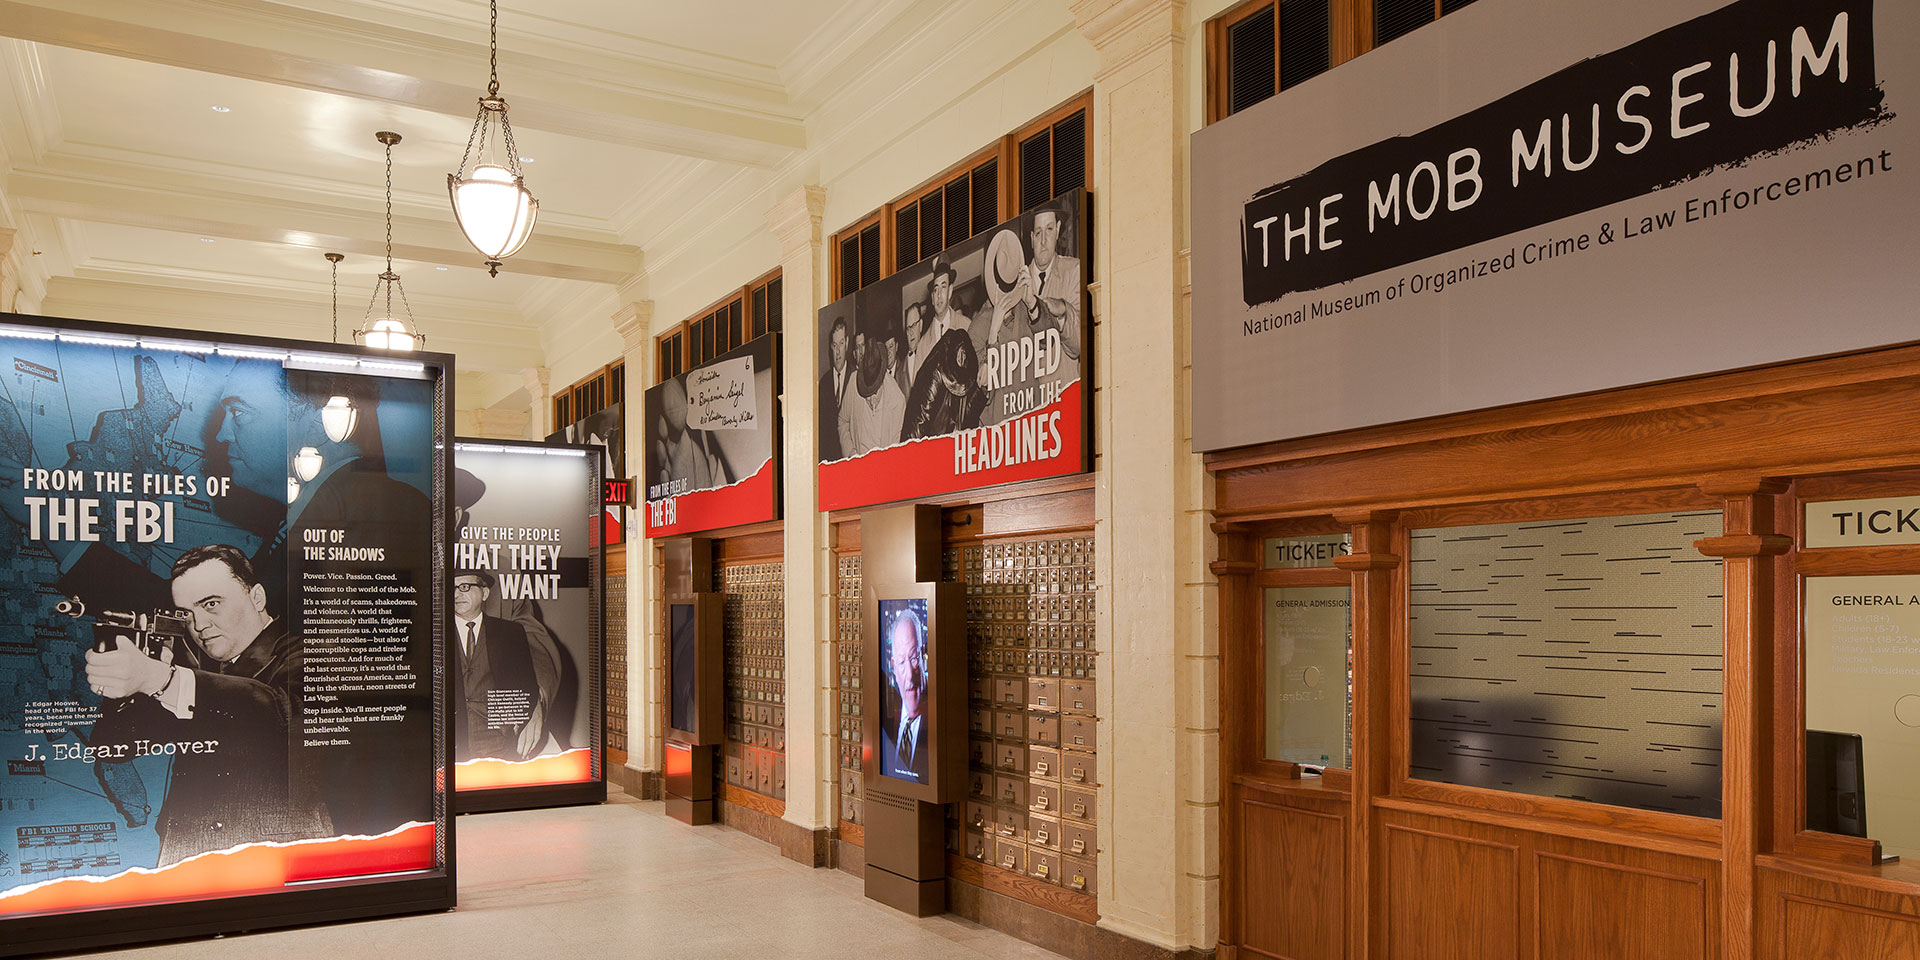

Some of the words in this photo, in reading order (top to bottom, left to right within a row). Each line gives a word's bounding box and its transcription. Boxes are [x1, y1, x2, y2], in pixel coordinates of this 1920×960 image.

[1252, 193, 1344, 268] THE
[1367, 147, 1484, 235] MOB
[1509, 10, 1849, 189] MUSEUM
[1242, 302, 1306, 338] National
[1310, 287, 1380, 319] Museum
[1385, 278, 1406, 301] of
[1410, 248, 1516, 297] Organized
[1522, 229, 1591, 267] Crime
[1598, 222, 1615, 245] &
[1622, 206, 1676, 240] Law
[1683, 147, 1893, 224] Enforcement
[746, 357, 750, 369] 6
[987, 328, 1061, 391] RIPPED
[1004, 387, 1034, 415] FROM
[1040, 380, 1061, 408] THE
[955, 412, 1062, 475] HEADLINES
[24, 468, 83, 491] FROM
[94, 471, 132, 493] THE
[143, 473, 197, 495] FILES
[206, 476, 230, 497] OF
[606, 482, 627, 502] EXIT
[24, 497, 100, 541] THE
[116, 500, 174, 543] FBI
[651, 500, 663, 528] THE
[666, 498, 676, 526] FBI
[304, 529, 327, 543] OUT
[330, 529, 344, 543] OF
[461, 527, 488, 540] GIVE
[493, 527, 513, 540] THE
[519, 528, 560, 541] PEOPLE
[304, 547, 325, 560] THE
[328, 548, 385, 562] SHADOWS
[509, 544, 561, 570] THEY
[1276, 542, 1348, 561] TICKETS
[499, 574, 560, 600] WANT
[1276, 600, 1308, 608] GENERAL
[1310, 600, 1350, 608] ADMISSION
[1832, 596, 1903, 606] GENERAL
[304, 646, 349, 654] incorruptible
[384, 705, 406, 713] people
[25, 745, 46, 761] J.
[54, 742, 127, 764] Edgar
[135, 738, 219, 759] Hoover
[14, 763, 40, 772] Miami
[40, 826, 77, 834] TRAINING
[80, 823, 111, 831] SCHOOLS
